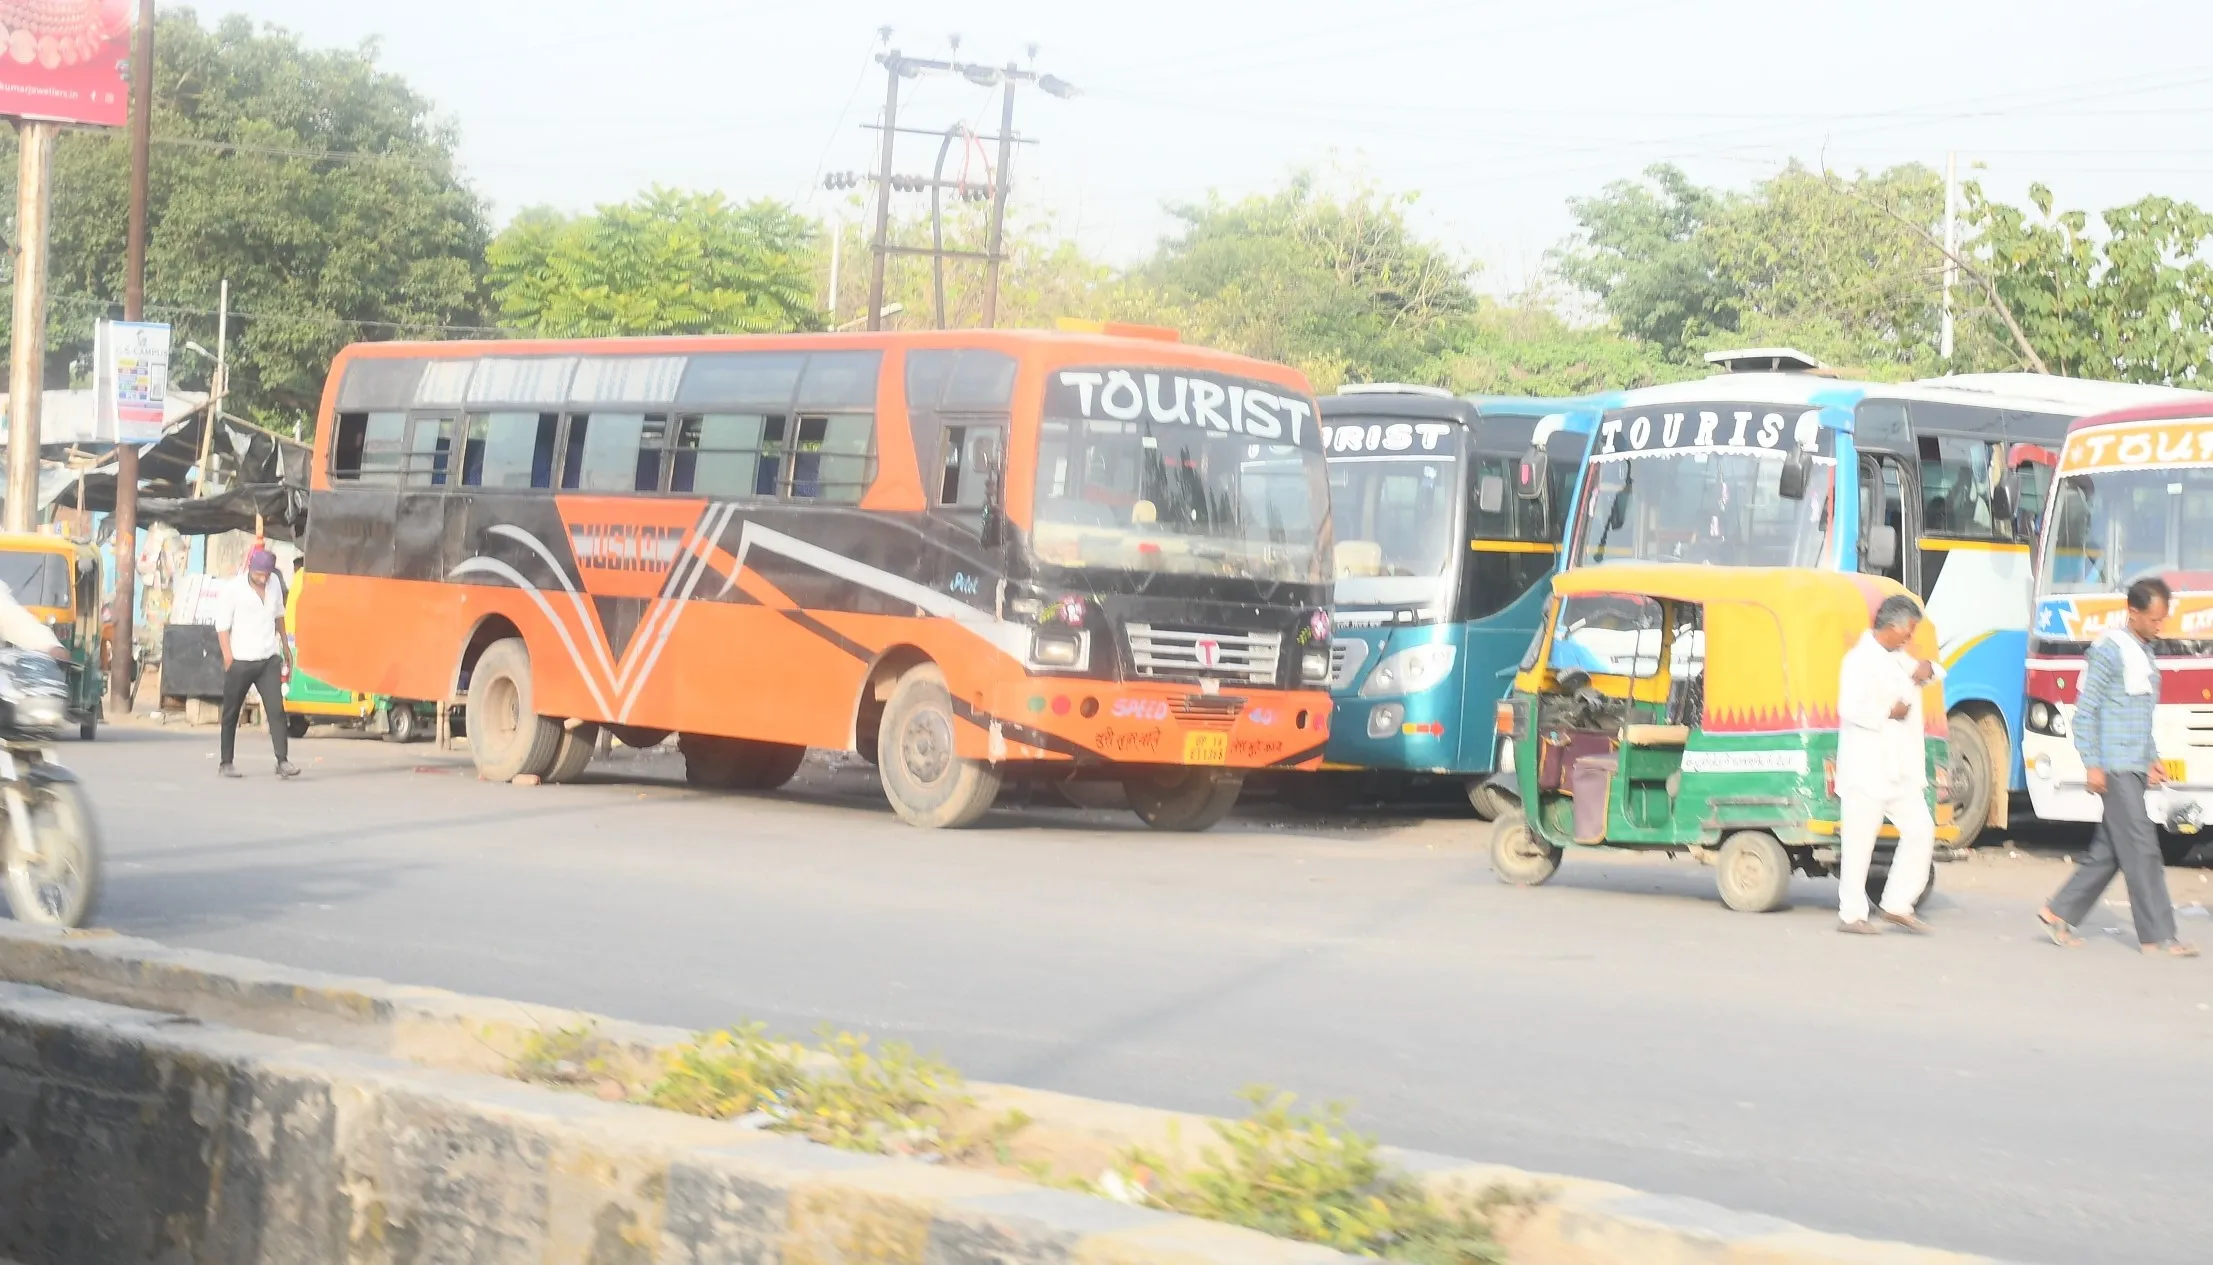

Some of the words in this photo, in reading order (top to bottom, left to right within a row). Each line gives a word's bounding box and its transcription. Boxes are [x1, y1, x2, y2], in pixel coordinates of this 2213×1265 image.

[1059, 369, 1311, 446] TOURIST
[568, 524, 686, 572] MUSKAN
[1112, 697, 1168, 720] SPEED
